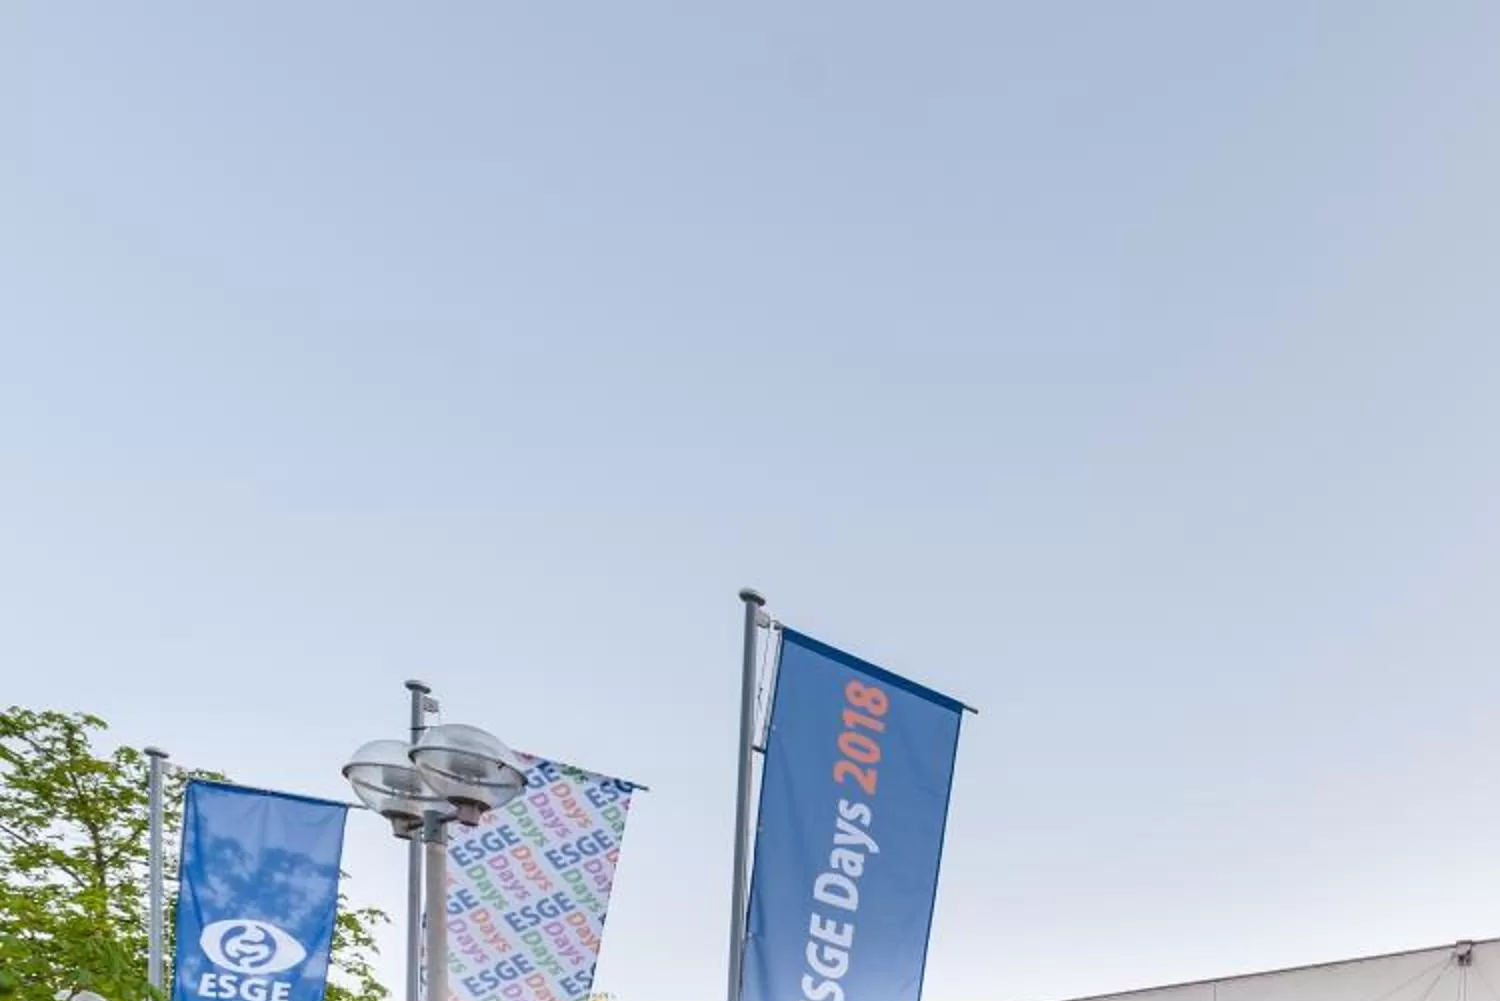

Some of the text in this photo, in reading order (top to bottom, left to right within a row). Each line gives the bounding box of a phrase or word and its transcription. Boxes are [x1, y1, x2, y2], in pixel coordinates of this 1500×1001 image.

[833, 679, 890, 795] 2018
[524, 761, 560, 789] GE
[584, 779, 633, 808] ESG
[506, 800, 549, 848] Days
[528, 792, 572, 838] Days
[551, 782, 593, 829] Days
[450, 825, 521, 867] ESGE
[545, 829, 613, 870] ESGE
[813, 798, 881, 912] Days
[466, 864, 508, 909] Days
[488, 854, 531, 900] Days
[511, 845, 553, 892] Days
[561, 868, 602, 912] Days
[584, 849, 612, 893] Day
[447, 888, 480, 915] GE
[504, 891, 576, 932] ESGE
[448, 918, 490, 963] Days
[470, 908, 512, 952] Days
[543, 921, 586, 965] Days
[521, 929, 565, 976] Days
[462, 953, 536, 997] ESGE
